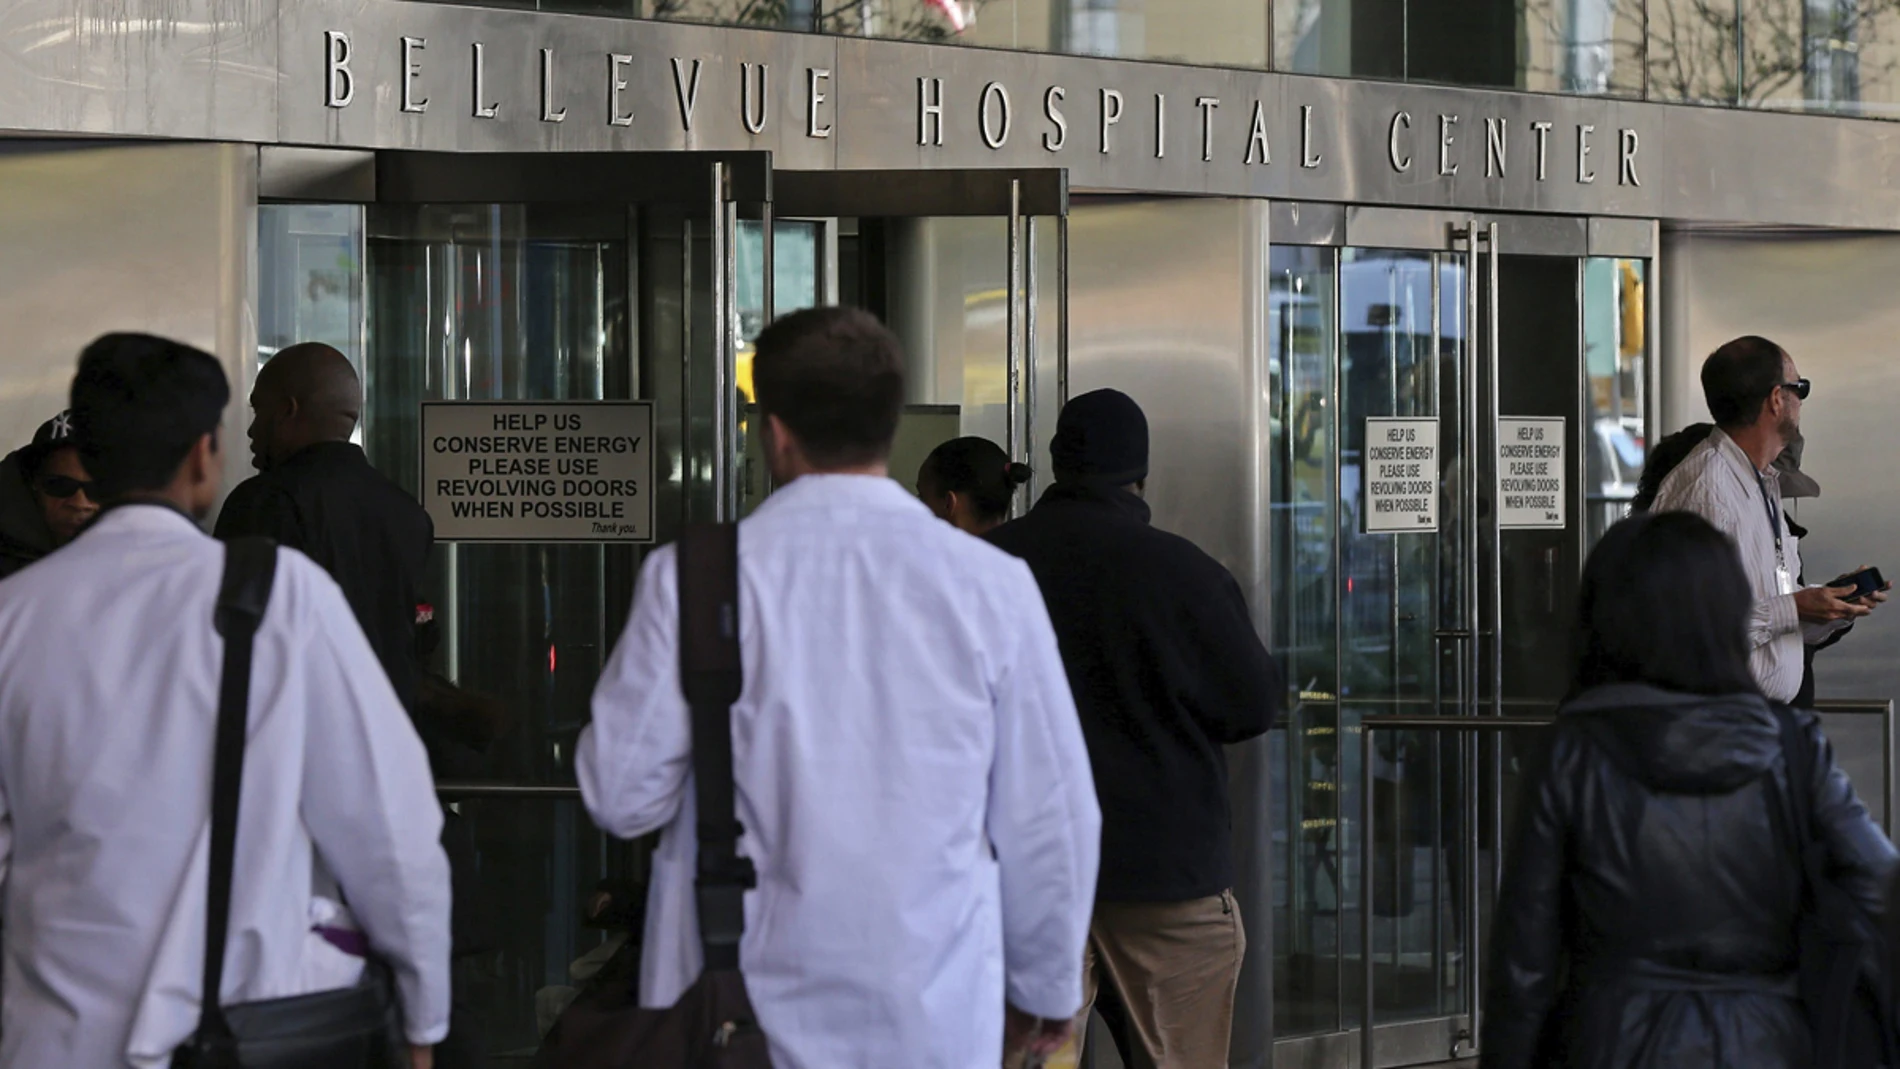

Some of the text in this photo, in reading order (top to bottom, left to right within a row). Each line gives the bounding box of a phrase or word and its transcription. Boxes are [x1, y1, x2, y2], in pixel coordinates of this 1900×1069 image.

[324, 31, 1642, 187] BELLEVUE HOSPITAL CENTER
[493, 414, 582, 431] HELP US
[1387, 428, 1416, 442] HELP US
[1517, 427, 1544, 441] HELP US
[433, 436, 642, 453] CONSERVE ENERGY
[1370, 446, 1434, 461] CONSERVE ENERGY
[1500, 445, 1560, 459] CONSERVE ENERGY
[469, 458, 599, 475] PLEASE USE
[1380, 464, 1420, 478] PLEASE USE
[1510, 462, 1548, 475] PLEASE USE
[437, 479, 638, 497] REVOLVING DOORS
[1371, 481, 1433, 495] REVOLVING DOORS
[1501, 479, 1559, 492] REVOLVING DOORS
[1375, 499, 1428, 512] WHEN POSSIBLE
[1505, 495, 1555, 508] WHEN POSSIBLE
[451, 501, 625, 518] WHEN POSSIBLE
[591, 522, 637, 536] Thank you.
